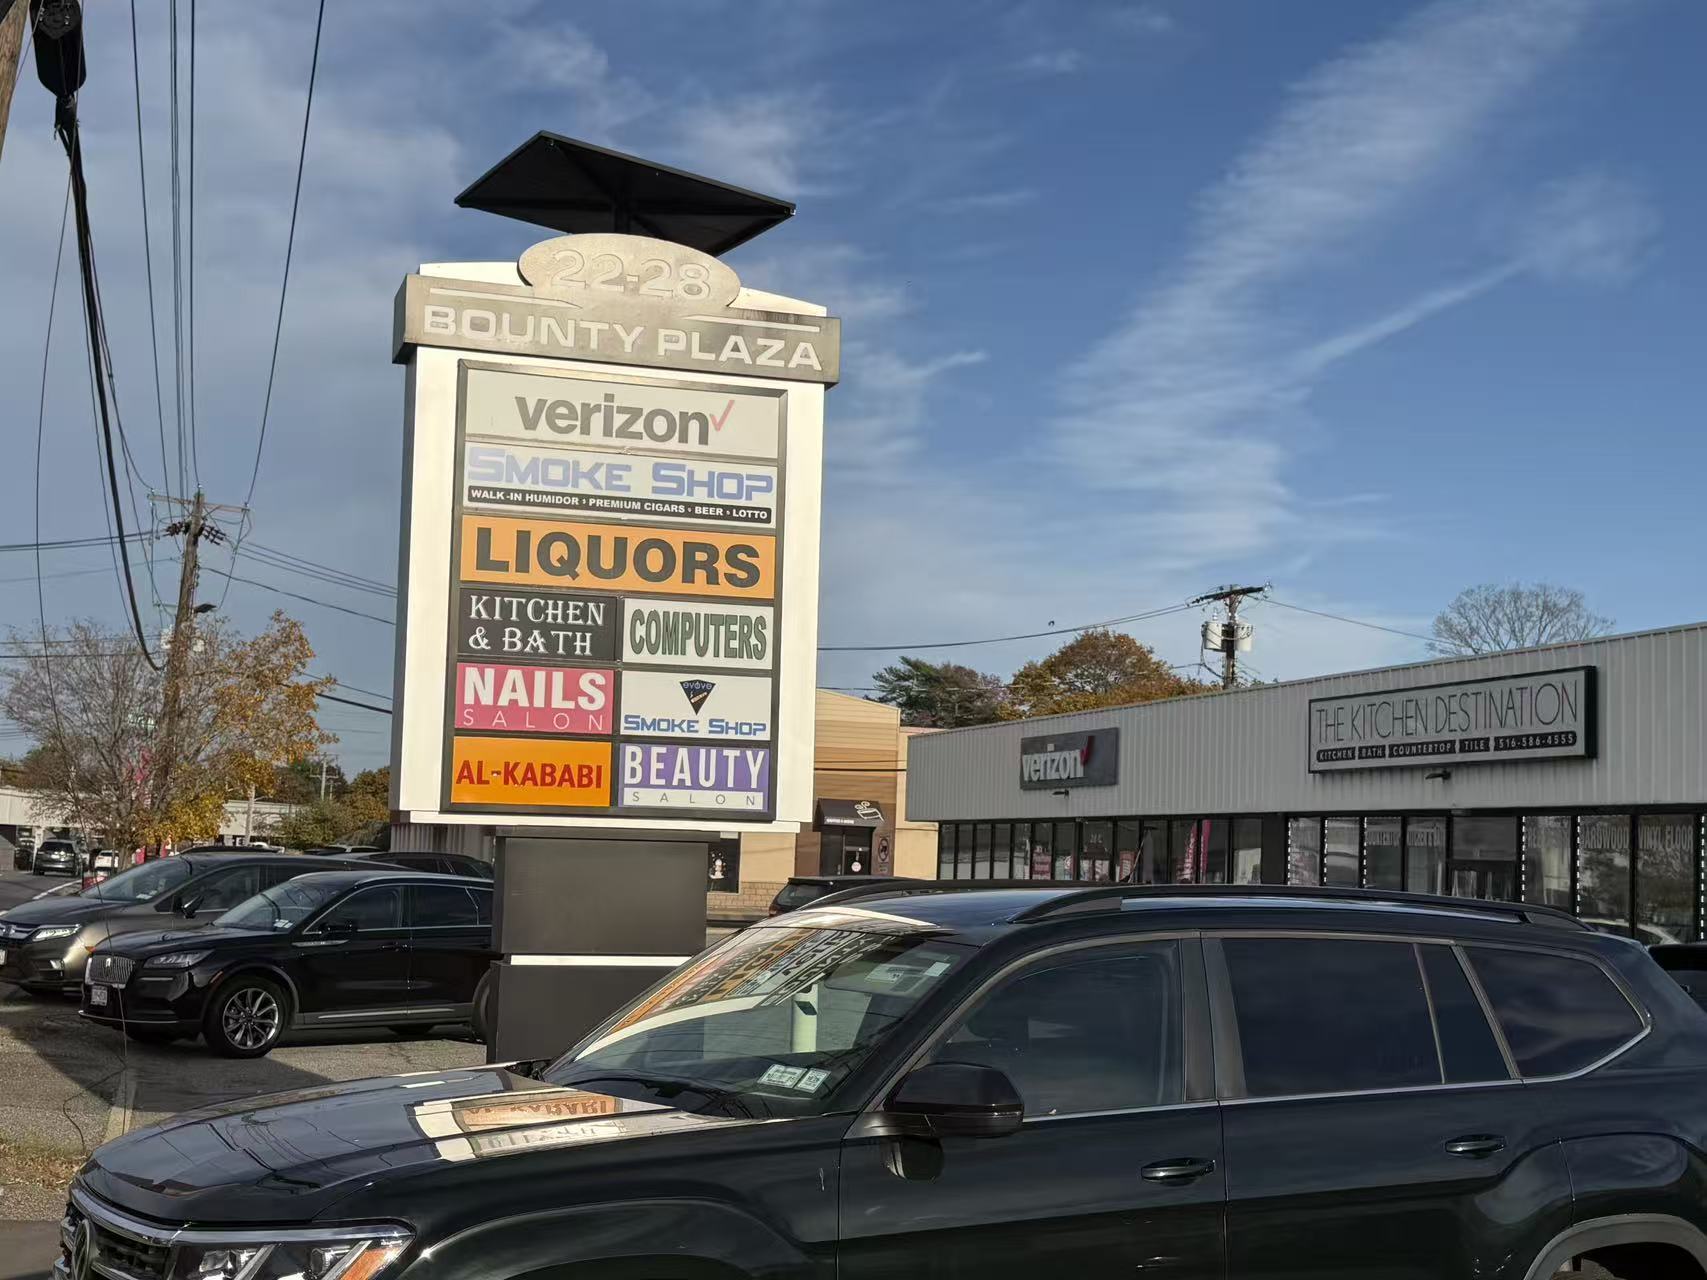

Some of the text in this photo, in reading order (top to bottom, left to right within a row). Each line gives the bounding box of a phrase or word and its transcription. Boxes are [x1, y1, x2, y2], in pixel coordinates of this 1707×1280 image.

[551, 250, 711, 300] 22-28
[424, 305, 823, 371] BOUNTY PLAZA
[515, 393, 709, 446] verizon
[468, 447, 773, 501] SMOKE SHOP
[525, 493, 579, 505] HUMIDOR
[589, 499, 641, 510] PREMIUM
[644, 502, 685, 513] CIGARS
[695, 506, 723, 516] BEER
[732, 509, 768, 519] LOTTO
[475, 527, 761, 588] LIQUORS
[469, 595, 606, 626] KITCHEN
[468, 627, 593, 656] & BATH
[630, 608, 767, 661] COMPUTERS
[463, 667, 606, 711] NAILS
[463, 708, 603, 731] SALON
[623, 715, 767, 737] SMOKE SHOP
[1316, 680, 1578, 743] THE KITCHEN DESTINATION
[1021, 744, 1085, 782] verizon
[1393, 742, 1451, 756] COUNTERTOP
[1464, 740, 1485, 751] TILE
[456, 760, 602, 789] AL-KABABI
[624, 746, 765, 789] BEAUTY
[632, 791, 755, 806] SALON
[1580, 825, 1630, 849] ARDWOOD
